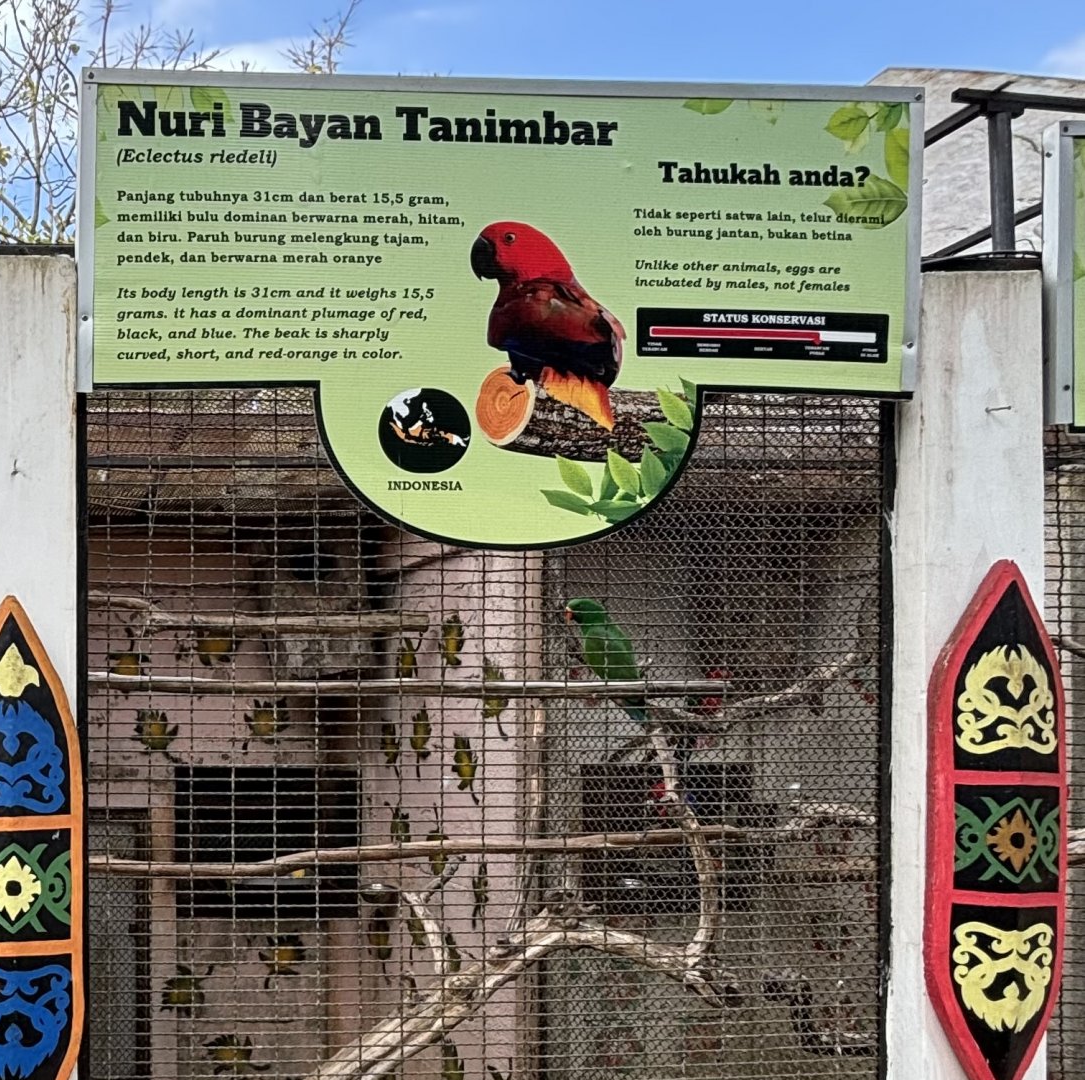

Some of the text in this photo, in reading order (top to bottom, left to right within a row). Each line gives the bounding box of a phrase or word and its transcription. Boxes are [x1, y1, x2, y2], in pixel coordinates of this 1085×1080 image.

[117, 100, 618, 149] Nuri Bayan Tanimbar
[116, 147, 203, 167] (Eclectus
[657, 160, 870, 188] Tahukah anda?
[116, 189, 449, 207] Panjang tubuhnya 31cm dan berat 15,5 gram,
[116, 210, 465, 227] memiliki bulu dominan berwarna merah, hitam,
[632, 207, 887, 227] Tidak seperti satwa lain, telur dierami
[633, 225, 853, 241] oleh burung jantan, bukan betina
[116, 251, 382, 267] pendek, dan berwarna merah oranye
[634, 259, 841, 276] Unlike other animals, eggs are
[634, 276, 850, 293] incubated by males, not females
[116, 286, 435, 302] Its body length is 31cm and it weighs 15,5
[116, 306, 427, 322] grams. it has a dominant plumage of red,
[702, 312, 826, 326] STATUS KONSERVASI
[116, 326, 389, 342] black, and blue. The beak is sharply
[116, 347, 403, 362] curved, short, and red-orange in color.
[387, 480, 463, 491] INDONESIA
